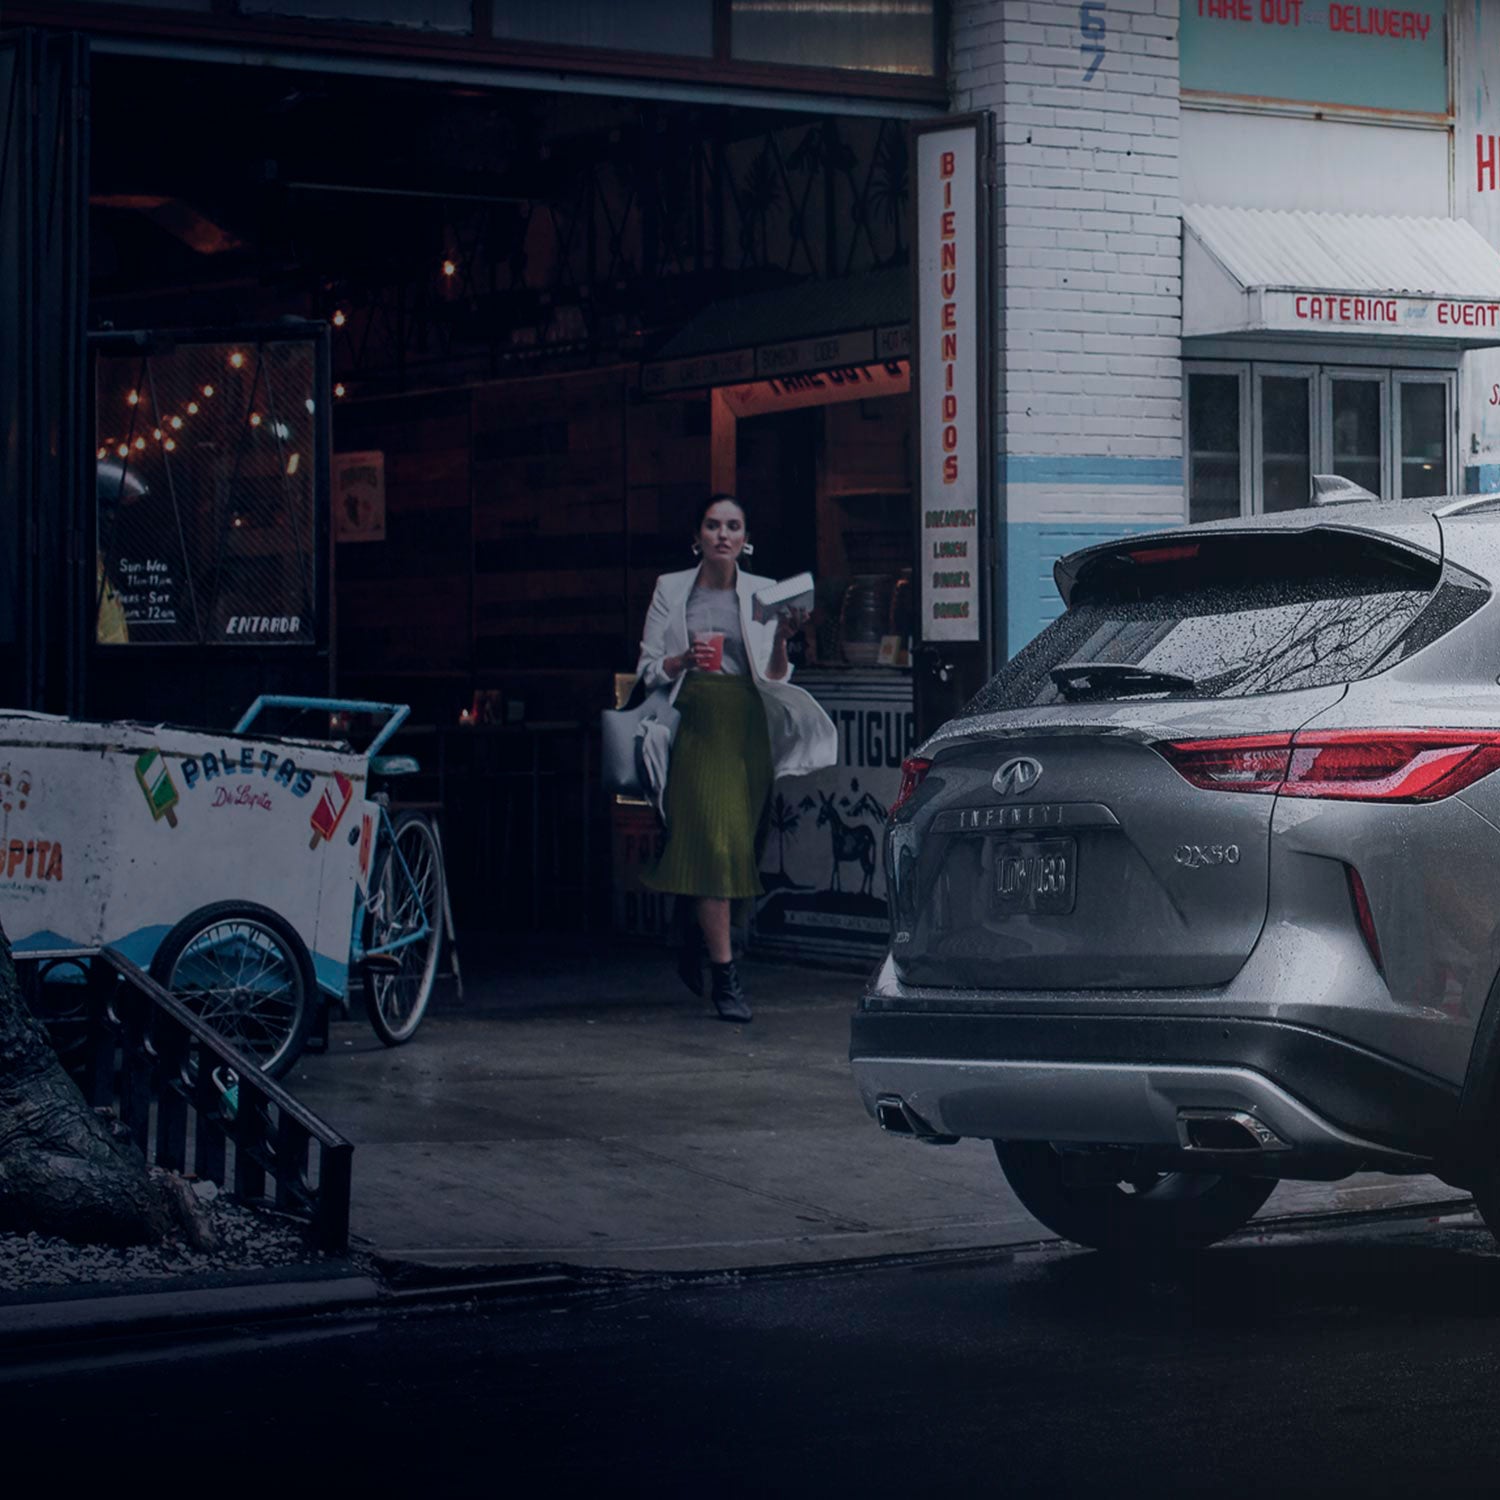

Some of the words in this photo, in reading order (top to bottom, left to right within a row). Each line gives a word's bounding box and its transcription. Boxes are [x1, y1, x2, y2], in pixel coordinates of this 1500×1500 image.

[1260, 0, 1302, 26] OUT
[1329, 3, 1431, 40] DELIVERY
[940, 151, 958, 485] BIENVENIDOS
[1295, 296, 1397, 322] CATERING
[226, 615, 300, 634] ENTRADA
[181, 747, 316, 798] PALETAS
[960, 805, 1064, 828] INFINITI
[1172, 844, 1242, 869] QX50
